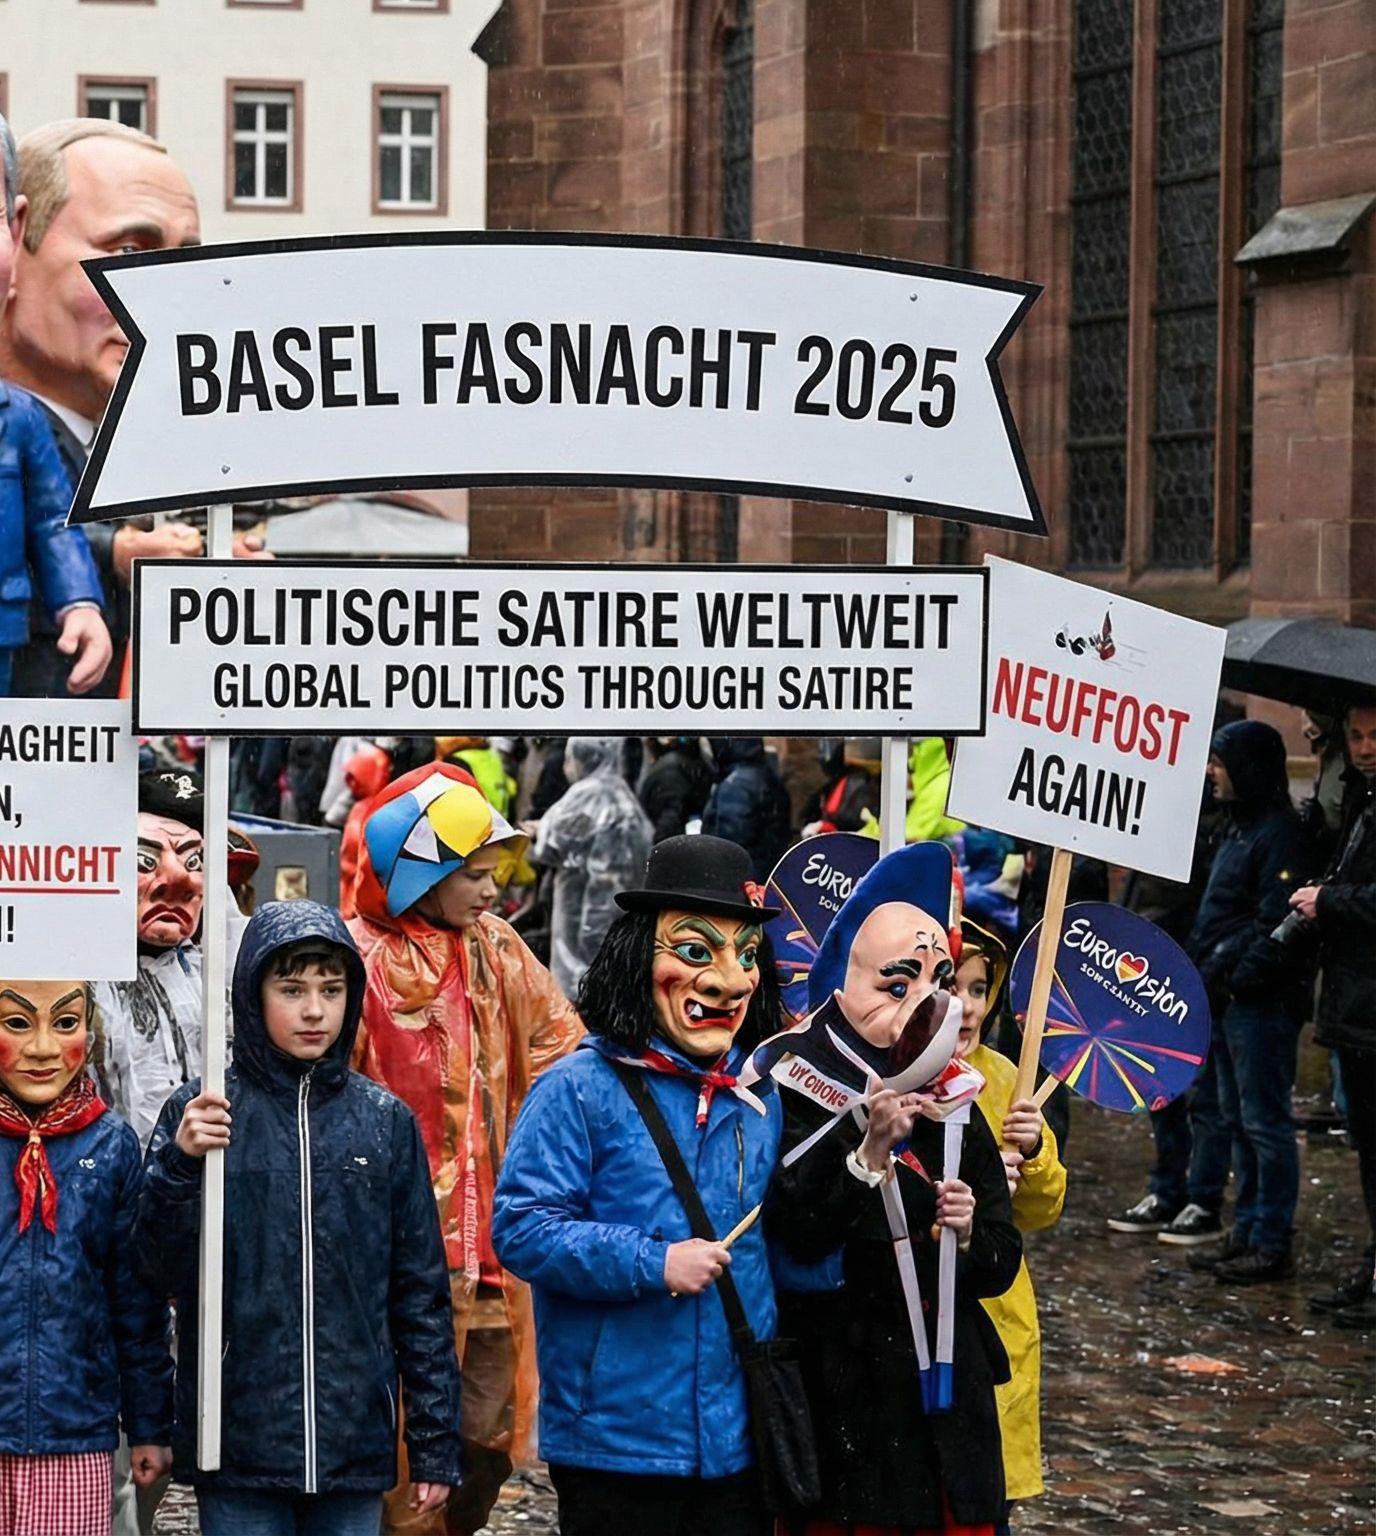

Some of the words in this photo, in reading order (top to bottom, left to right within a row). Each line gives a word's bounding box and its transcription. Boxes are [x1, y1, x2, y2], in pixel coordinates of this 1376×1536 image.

[176, 324, 400, 416] BASEL
[422, 321, 776, 411] FASNACHT
[794, 335, 957, 429] 2025
[170, 587, 480, 647] POLITISCHE
[497, 589, 679, 648] SATIRE
[696, 592, 959, 650] WELTWEIT
[213, 662, 371, 709] GLOBAL
[385, 664, 565, 710] POLITICS
[577, 665, 764, 710] THROUGH
[778, 665, 914, 710] SATIRE
[992, 657, 1190, 766] NEUFFOST
[1008, 747, 1147, 836] AGAIN!
